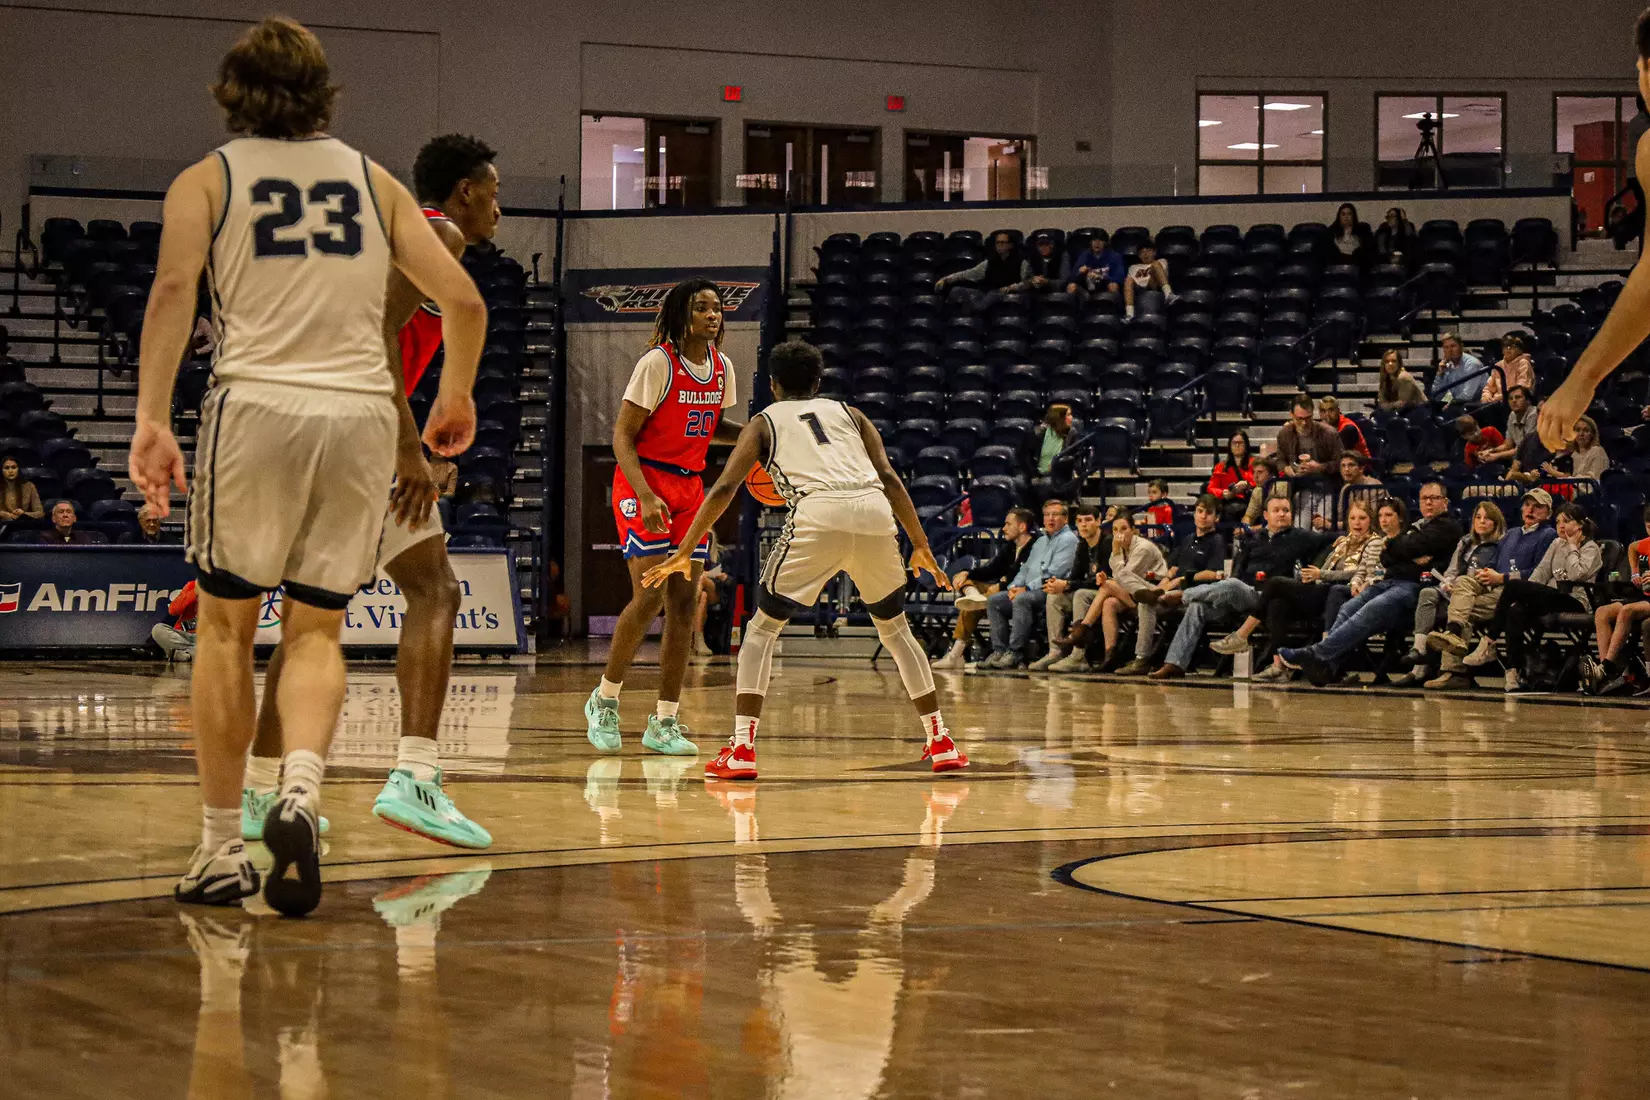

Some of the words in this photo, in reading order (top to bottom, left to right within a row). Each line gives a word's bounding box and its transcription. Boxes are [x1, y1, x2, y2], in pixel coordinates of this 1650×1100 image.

[249, 177, 363, 261] 23
[684, 409, 715, 437] 20
[798, 412, 832, 446] 1
[26, 583, 182, 612] AmFir
[345, 606, 363, 629] t.
[363, 605, 499, 630] Vint's
